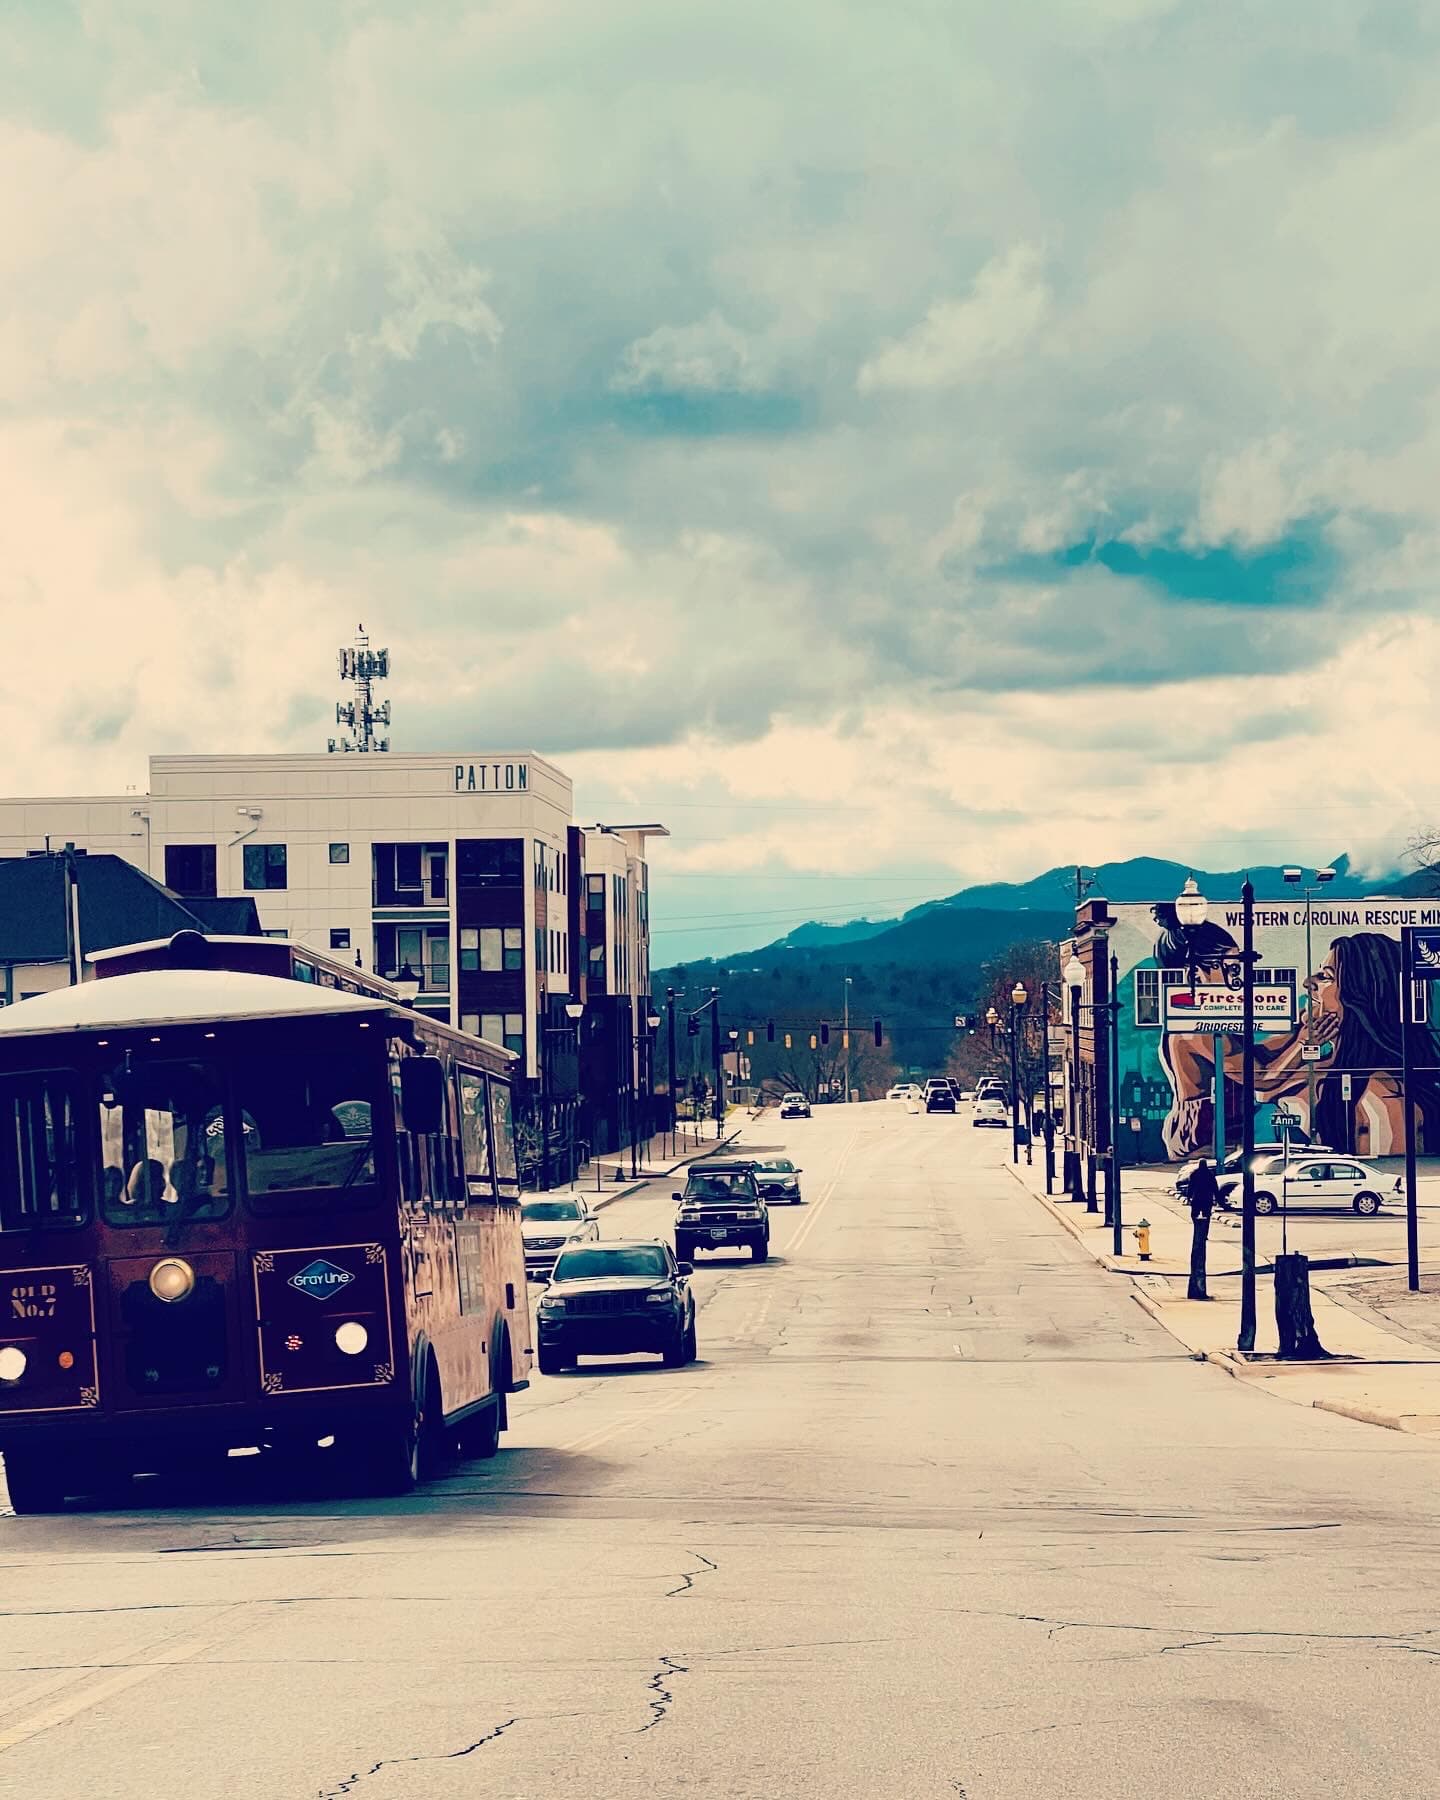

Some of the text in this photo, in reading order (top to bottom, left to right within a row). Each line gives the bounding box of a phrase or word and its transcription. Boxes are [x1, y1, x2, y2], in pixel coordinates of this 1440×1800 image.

[455, 764, 527, 790] PATTON
[1293, 910, 1359, 926] CAROLINA
[1365, 910, 1417, 925] RESCUE
[1198, 992, 1288, 1005] Firesone
[1194, 1021, 1265, 1032] BRIDGESTE
[1275, 1116, 1294, 1125] Ann
[294, 1272, 350, 1286] Gray Line
[11, 1285, 56, 1297] OLD
